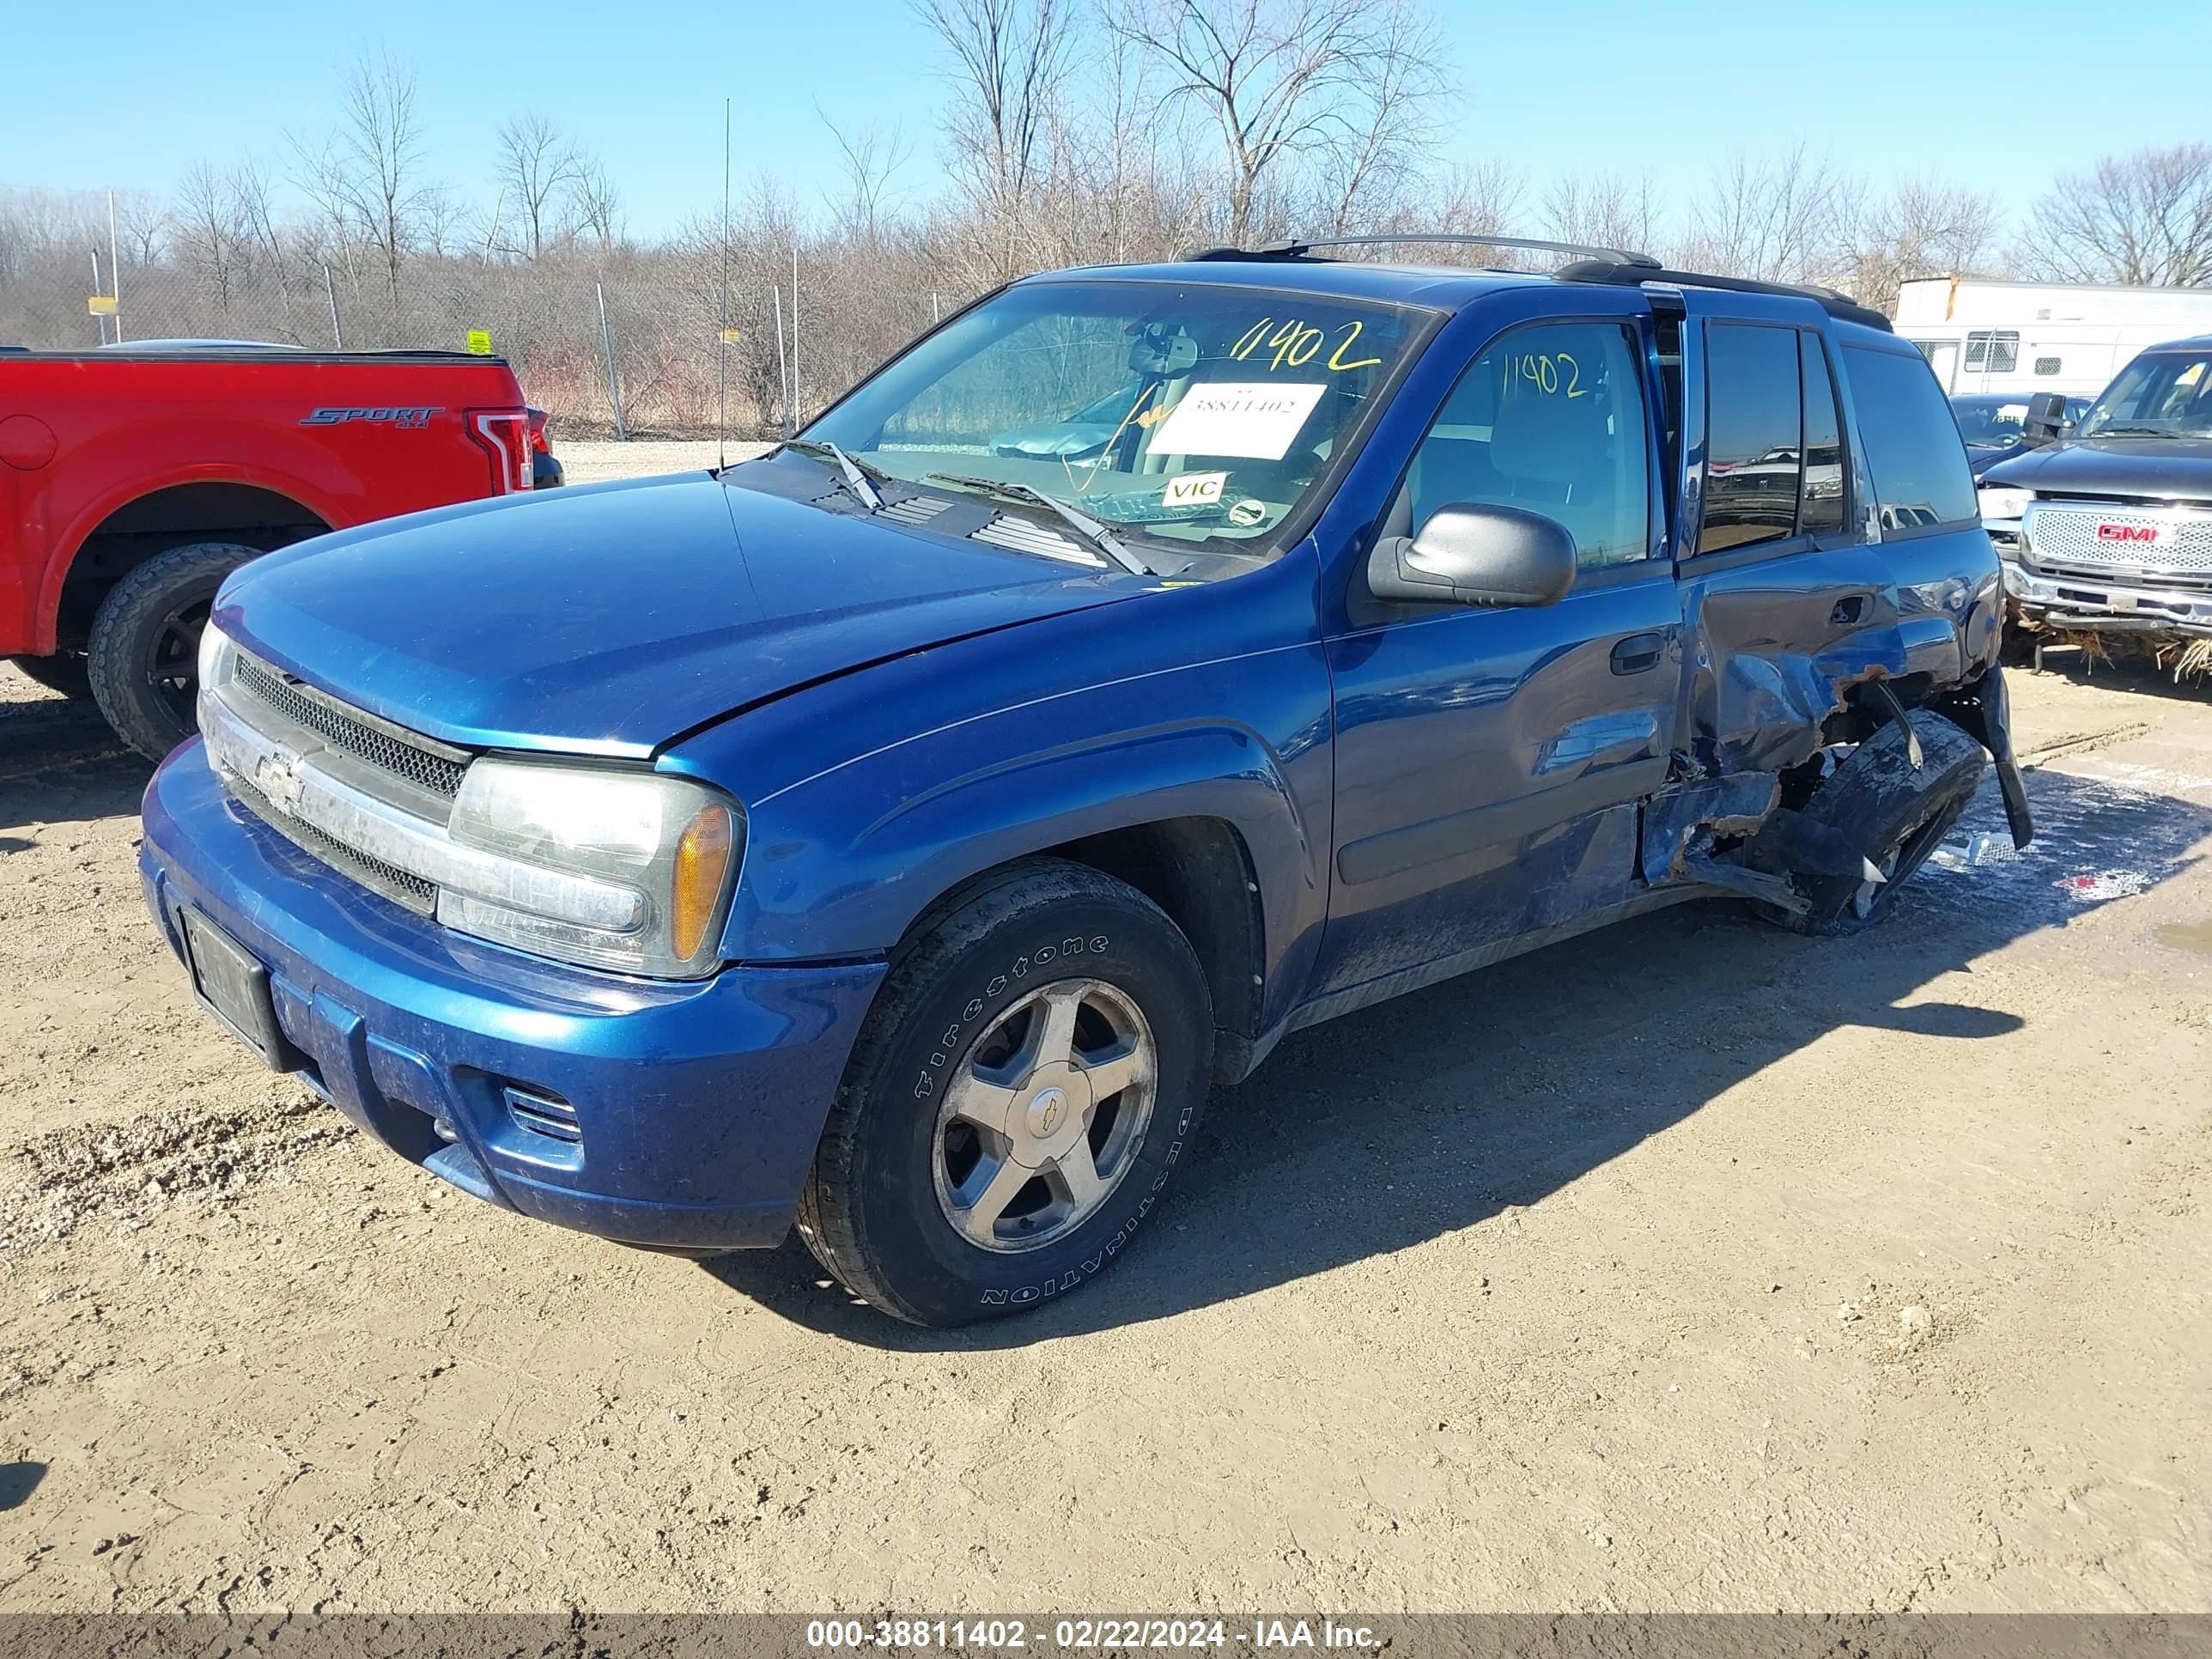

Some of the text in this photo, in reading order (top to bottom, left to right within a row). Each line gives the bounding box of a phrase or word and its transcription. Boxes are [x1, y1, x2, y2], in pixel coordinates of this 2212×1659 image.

[1229, 317, 1382, 372] 11402
[1503, 352, 1589, 398] 11402
[299, 407, 446, 426] SPORT
[1174, 481, 1218, 498] VIC
[914, 935, 1109, 1099] Firestone
[981, 1107, 1193, 1304] DESTINATION
